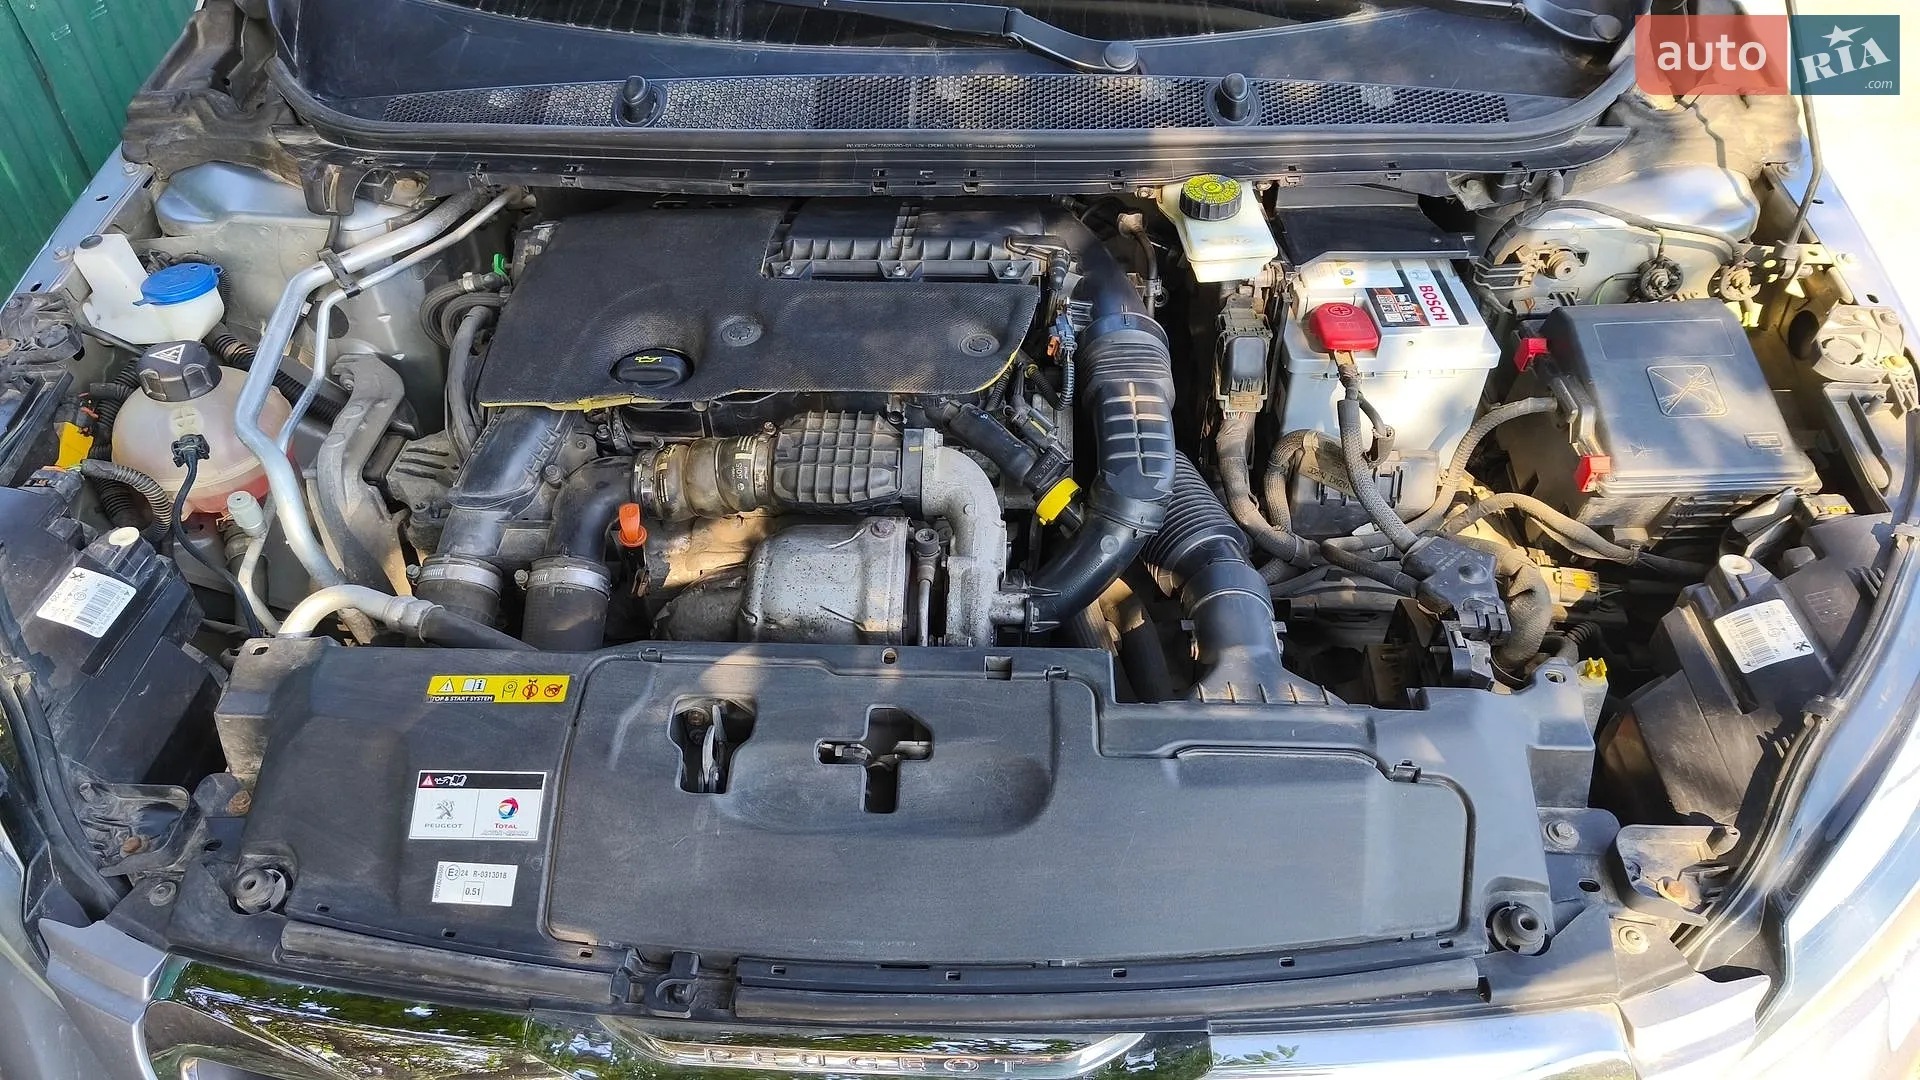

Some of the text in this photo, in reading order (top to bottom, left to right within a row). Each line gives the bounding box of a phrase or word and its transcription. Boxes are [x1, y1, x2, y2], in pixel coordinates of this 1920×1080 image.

[1418, 285, 1449, 321] BOSCH
[464, 887, 481, 896] 0.51
[703, 1047, 1025, 1073] PEUGEOT
